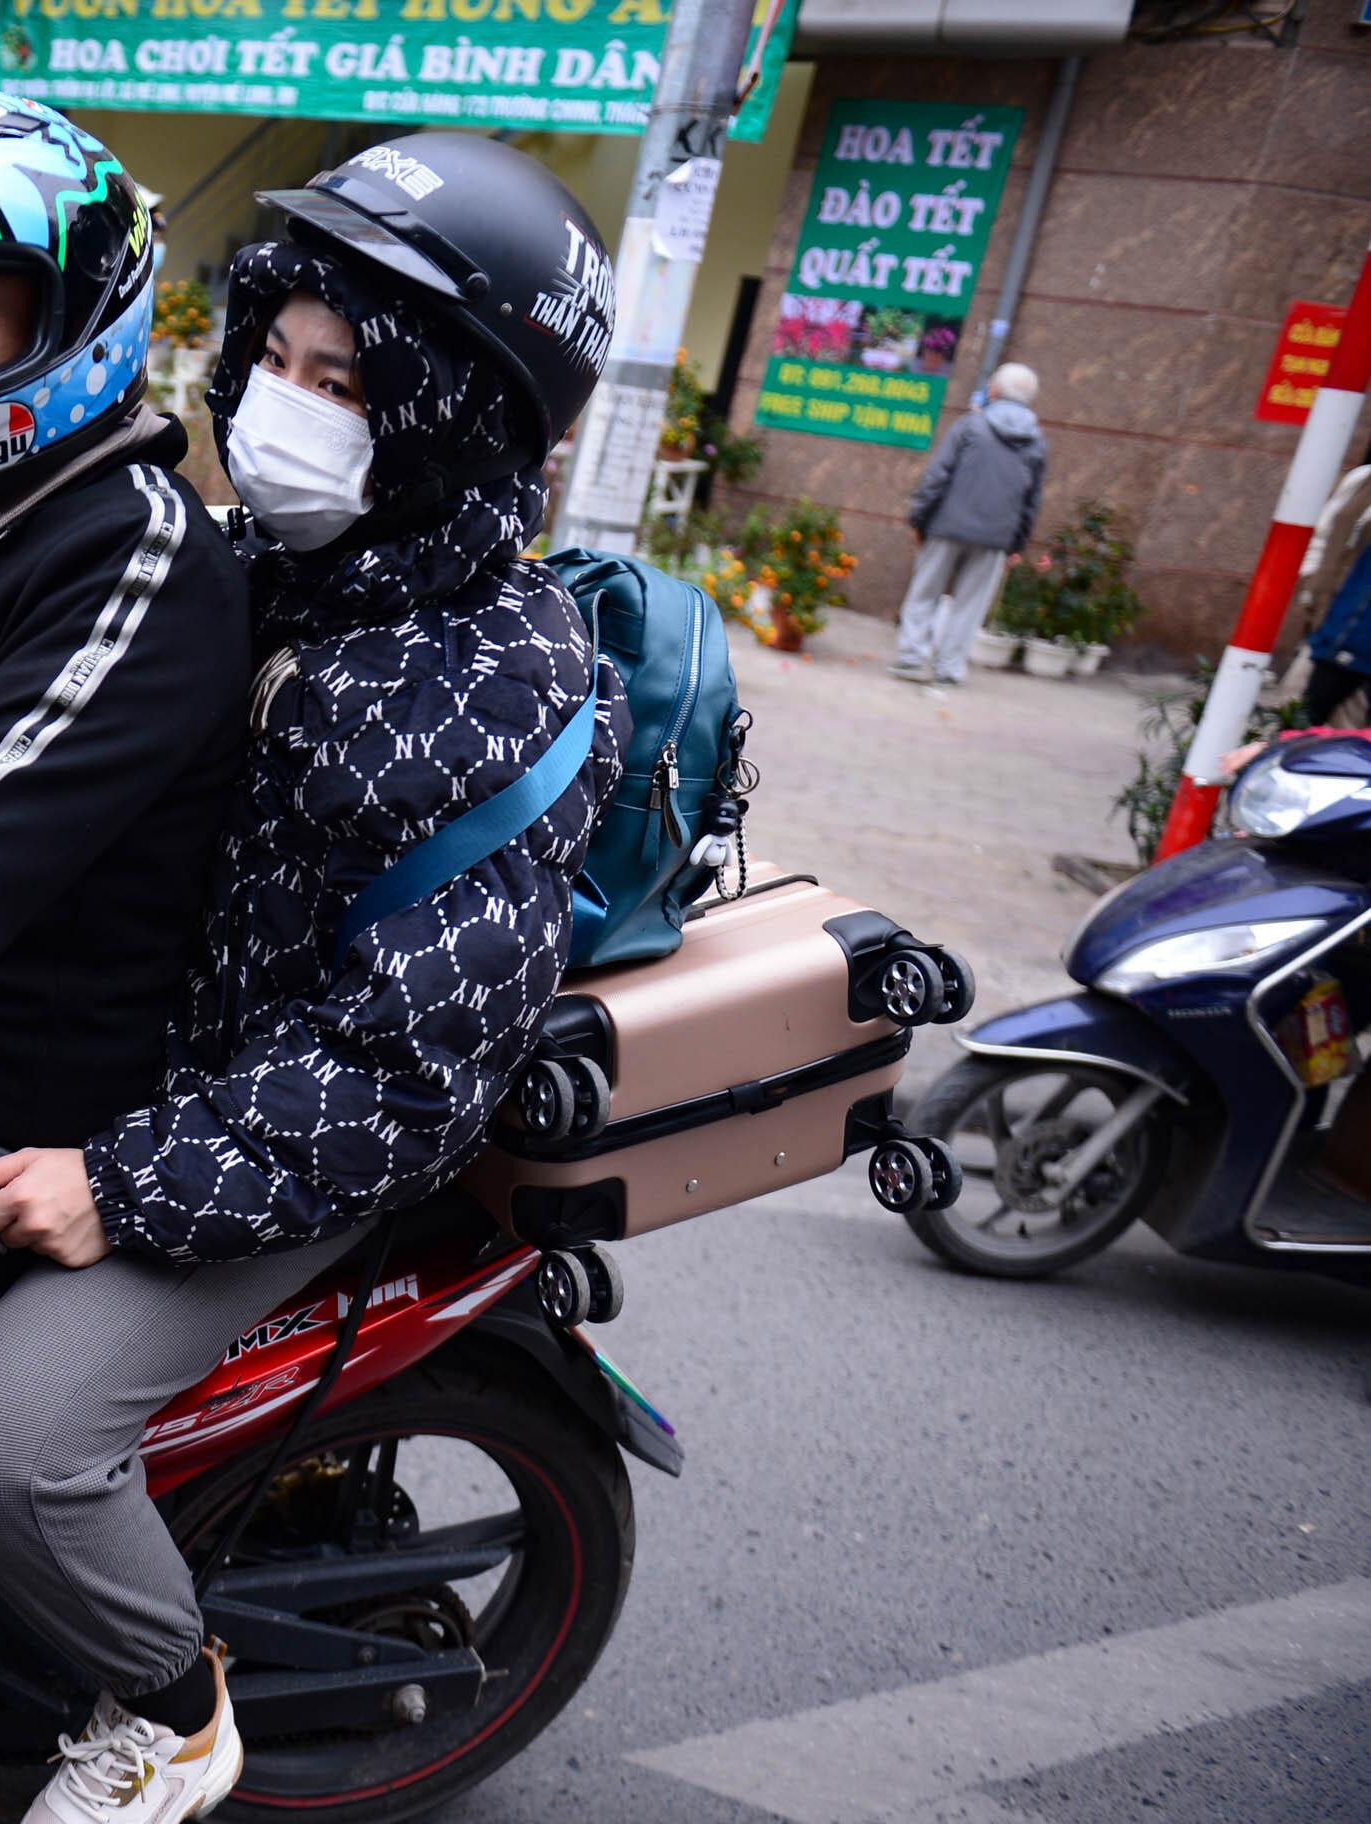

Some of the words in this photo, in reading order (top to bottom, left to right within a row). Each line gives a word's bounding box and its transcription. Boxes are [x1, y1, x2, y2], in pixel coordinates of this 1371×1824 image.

[49, 38, 128, 72] HOA
[236, 27, 320, 76] TẾT
[326, 34, 410, 80] GIÁ
[419, 36, 545, 85] BÌNH
[834, 124, 915, 165] HOA
[926, 112, 1004, 170] TẾT
[817, 178, 903, 229] ĐÀO
[907, 179, 985, 236] TẾT
[797, 236, 899, 289] QUẤT
[901, 243, 973, 297] TẾT
[361, 312, 398, 348] NY
[497, 582, 526, 613] NY
[391, 620, 430, 648] NY
[471, 638, 505, 676] NY
[313, 740, 350, 767] NY
[395, 732, 436, 760] NY
[485, 734, 525, 763] NY
[483, 895, 518, 930] NY
[132, 1164, 167, 1204] NY
[223, 1301, 334, 1365] MX
